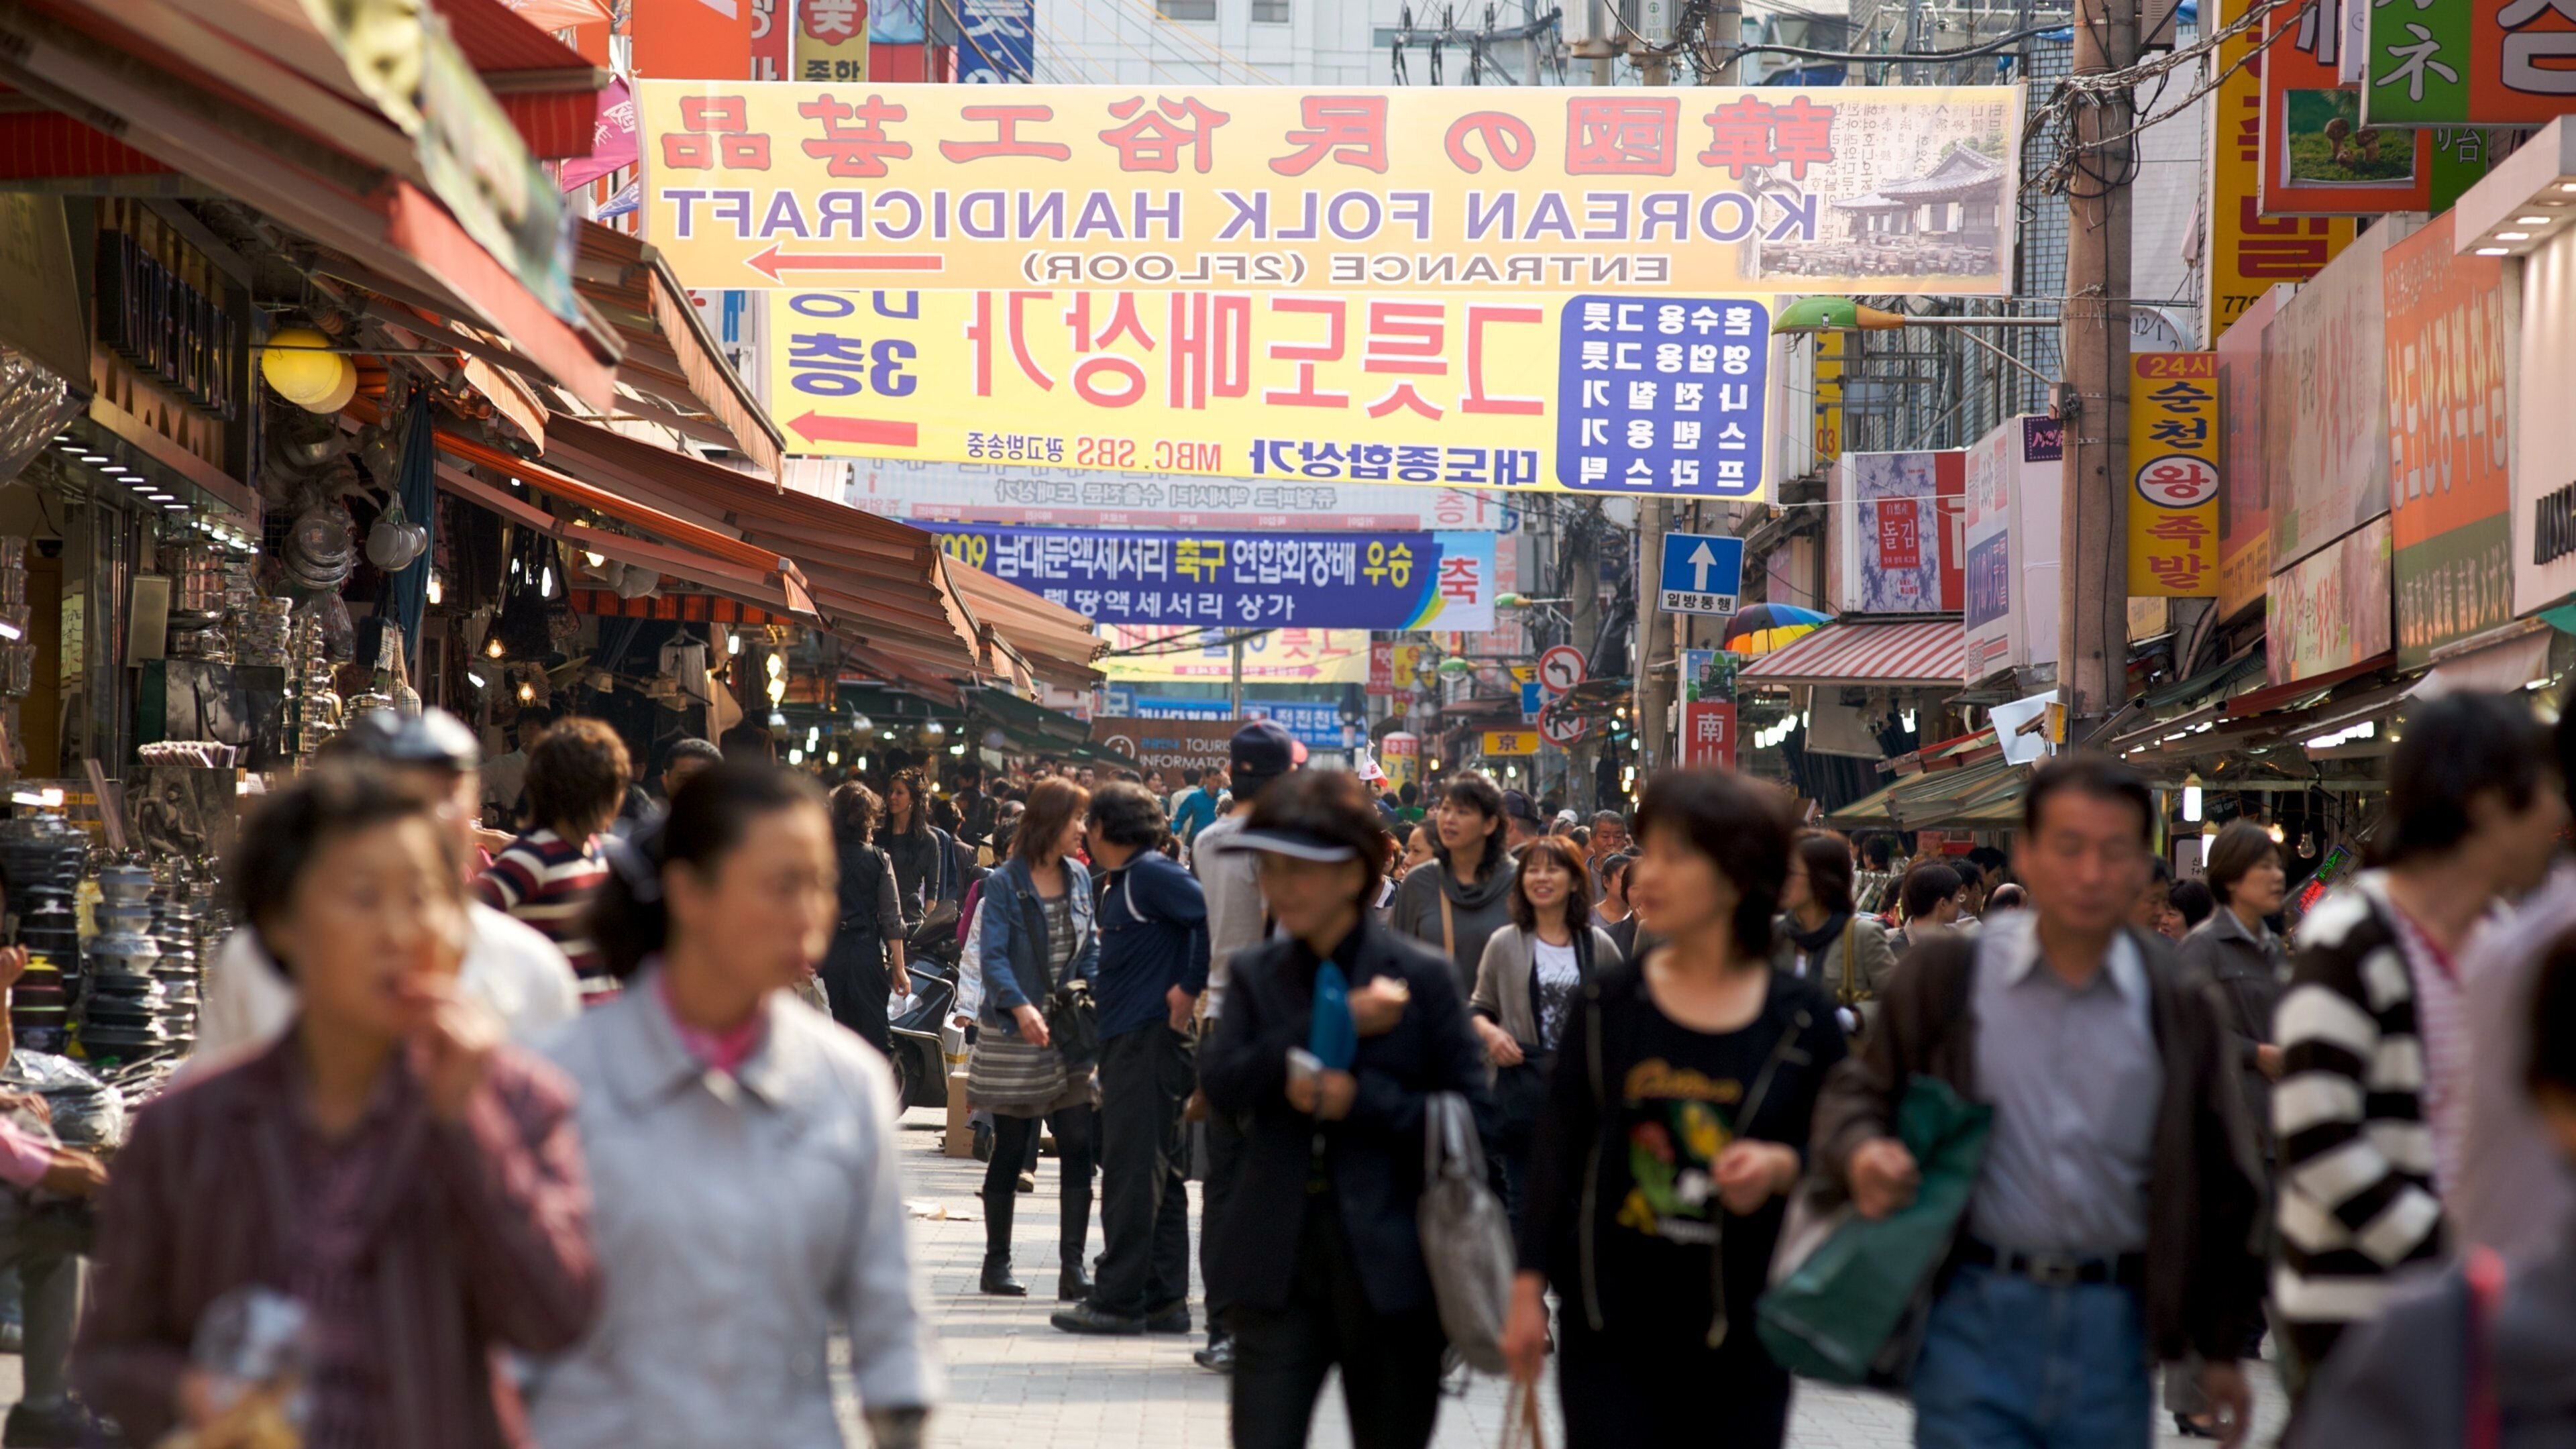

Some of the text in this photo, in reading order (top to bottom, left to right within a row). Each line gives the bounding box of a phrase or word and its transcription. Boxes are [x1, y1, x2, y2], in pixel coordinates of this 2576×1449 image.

[2149, 356, 2213, 377] 24시
[1882, 519, 1915, 550] 돌김
[1175, 538, 1226, 583] 축구
[1232, 539, 1356, 587] 연합회장배
[1363, 541, 1413, 588] 우승
[1440, 557, 1479, 604] 축
[1236, 592, 1295, 622] 상가
[1667, 592, 1732, 612] 일방통행
